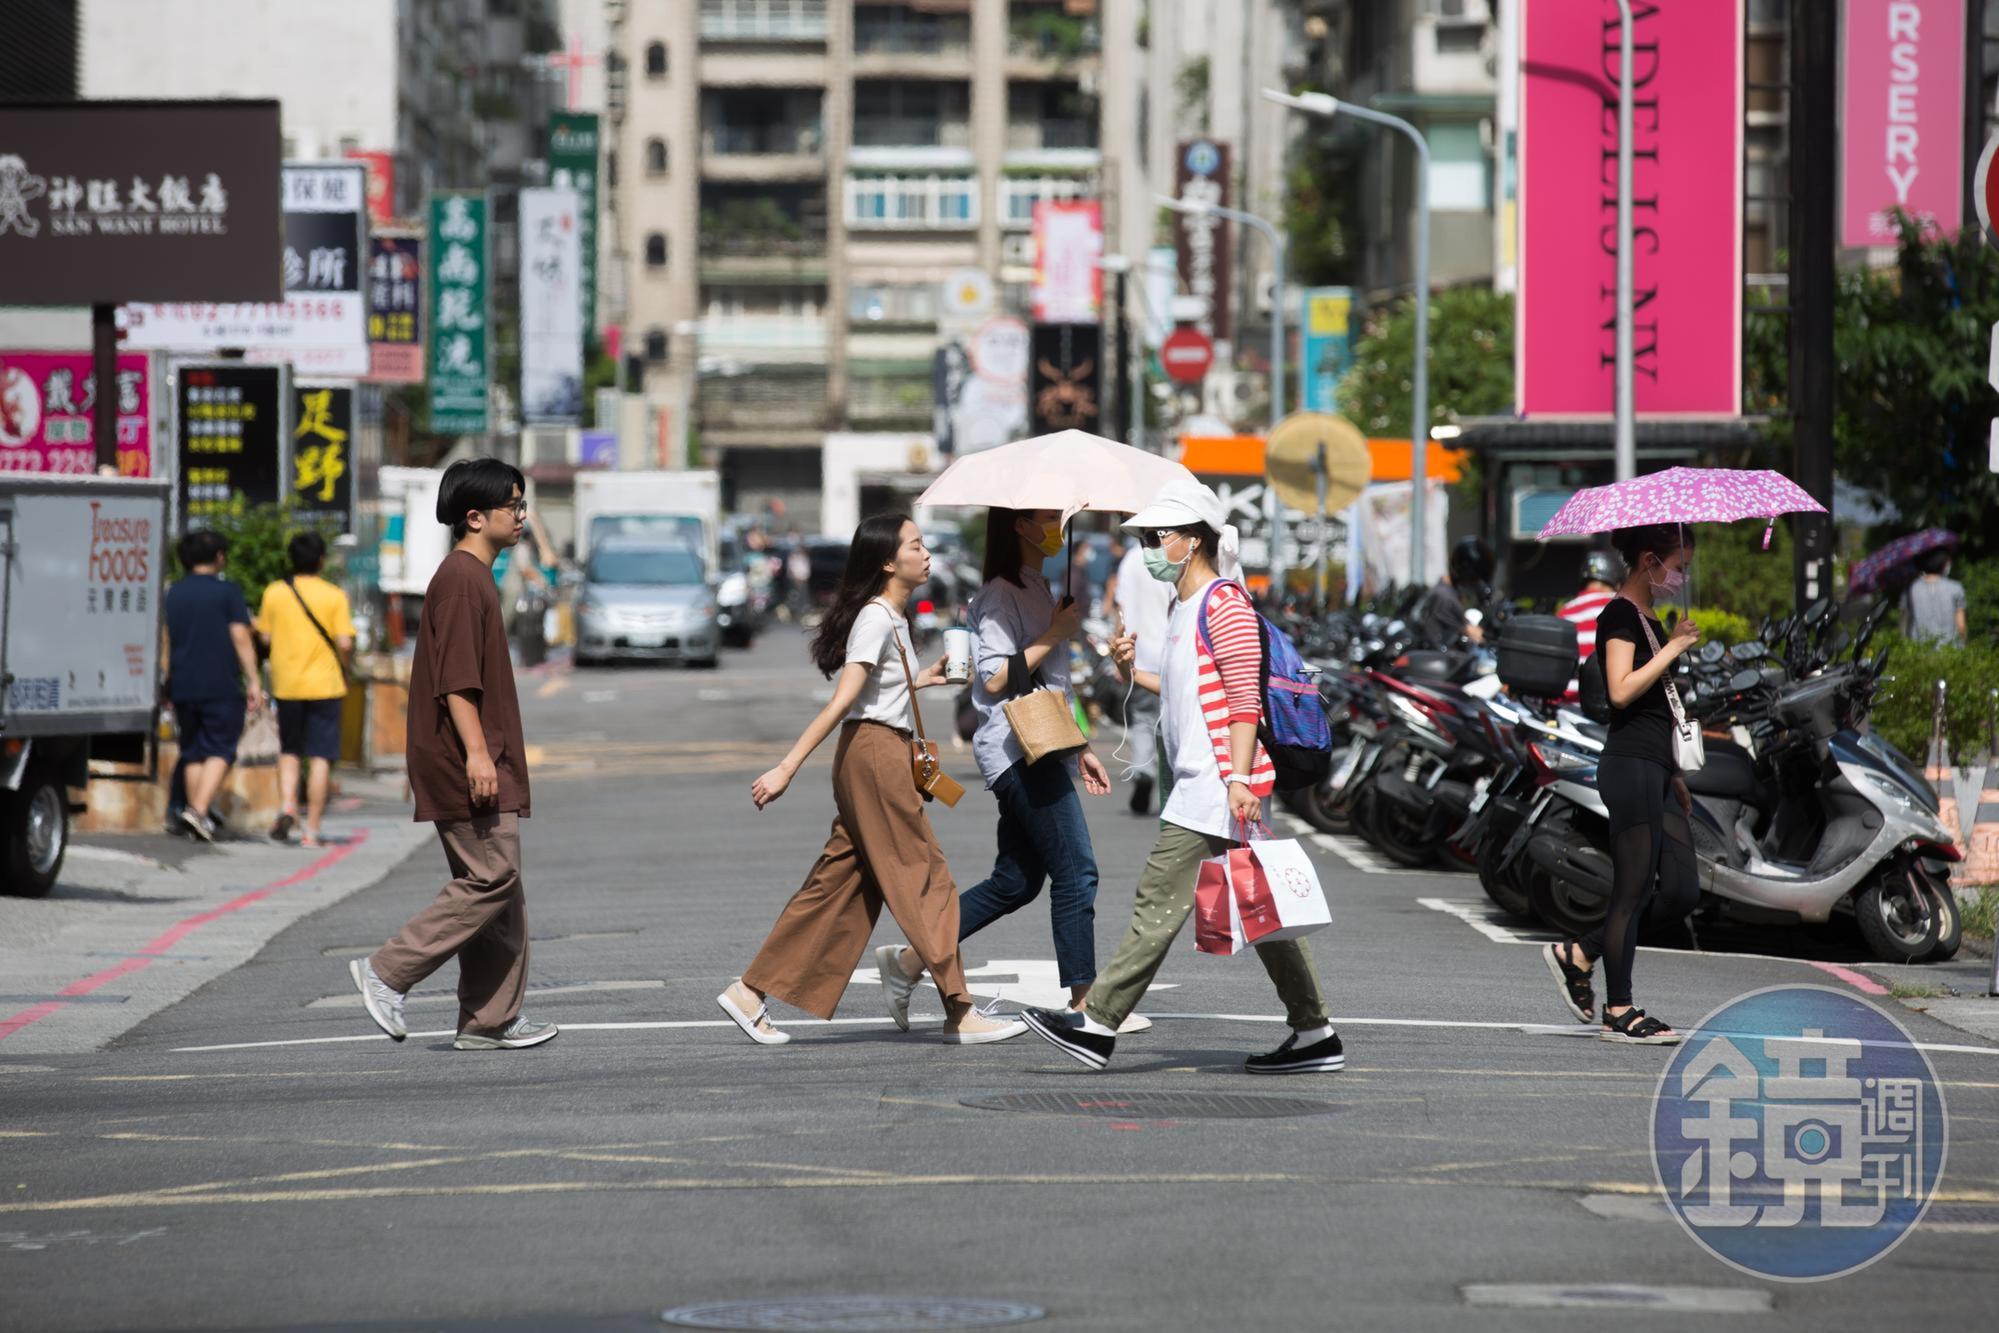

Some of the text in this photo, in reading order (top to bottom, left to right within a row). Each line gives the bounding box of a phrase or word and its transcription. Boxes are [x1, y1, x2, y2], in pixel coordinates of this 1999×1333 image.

[1885, 0, 1921, 204] RSERY
[48, 172, 228, 215] 神旺大飯店
[51, 215, 228, 235] SAN WANT HOTEL
[89, 501, 151, 543] Treasure
[88, 543, 150, 583] Foods
